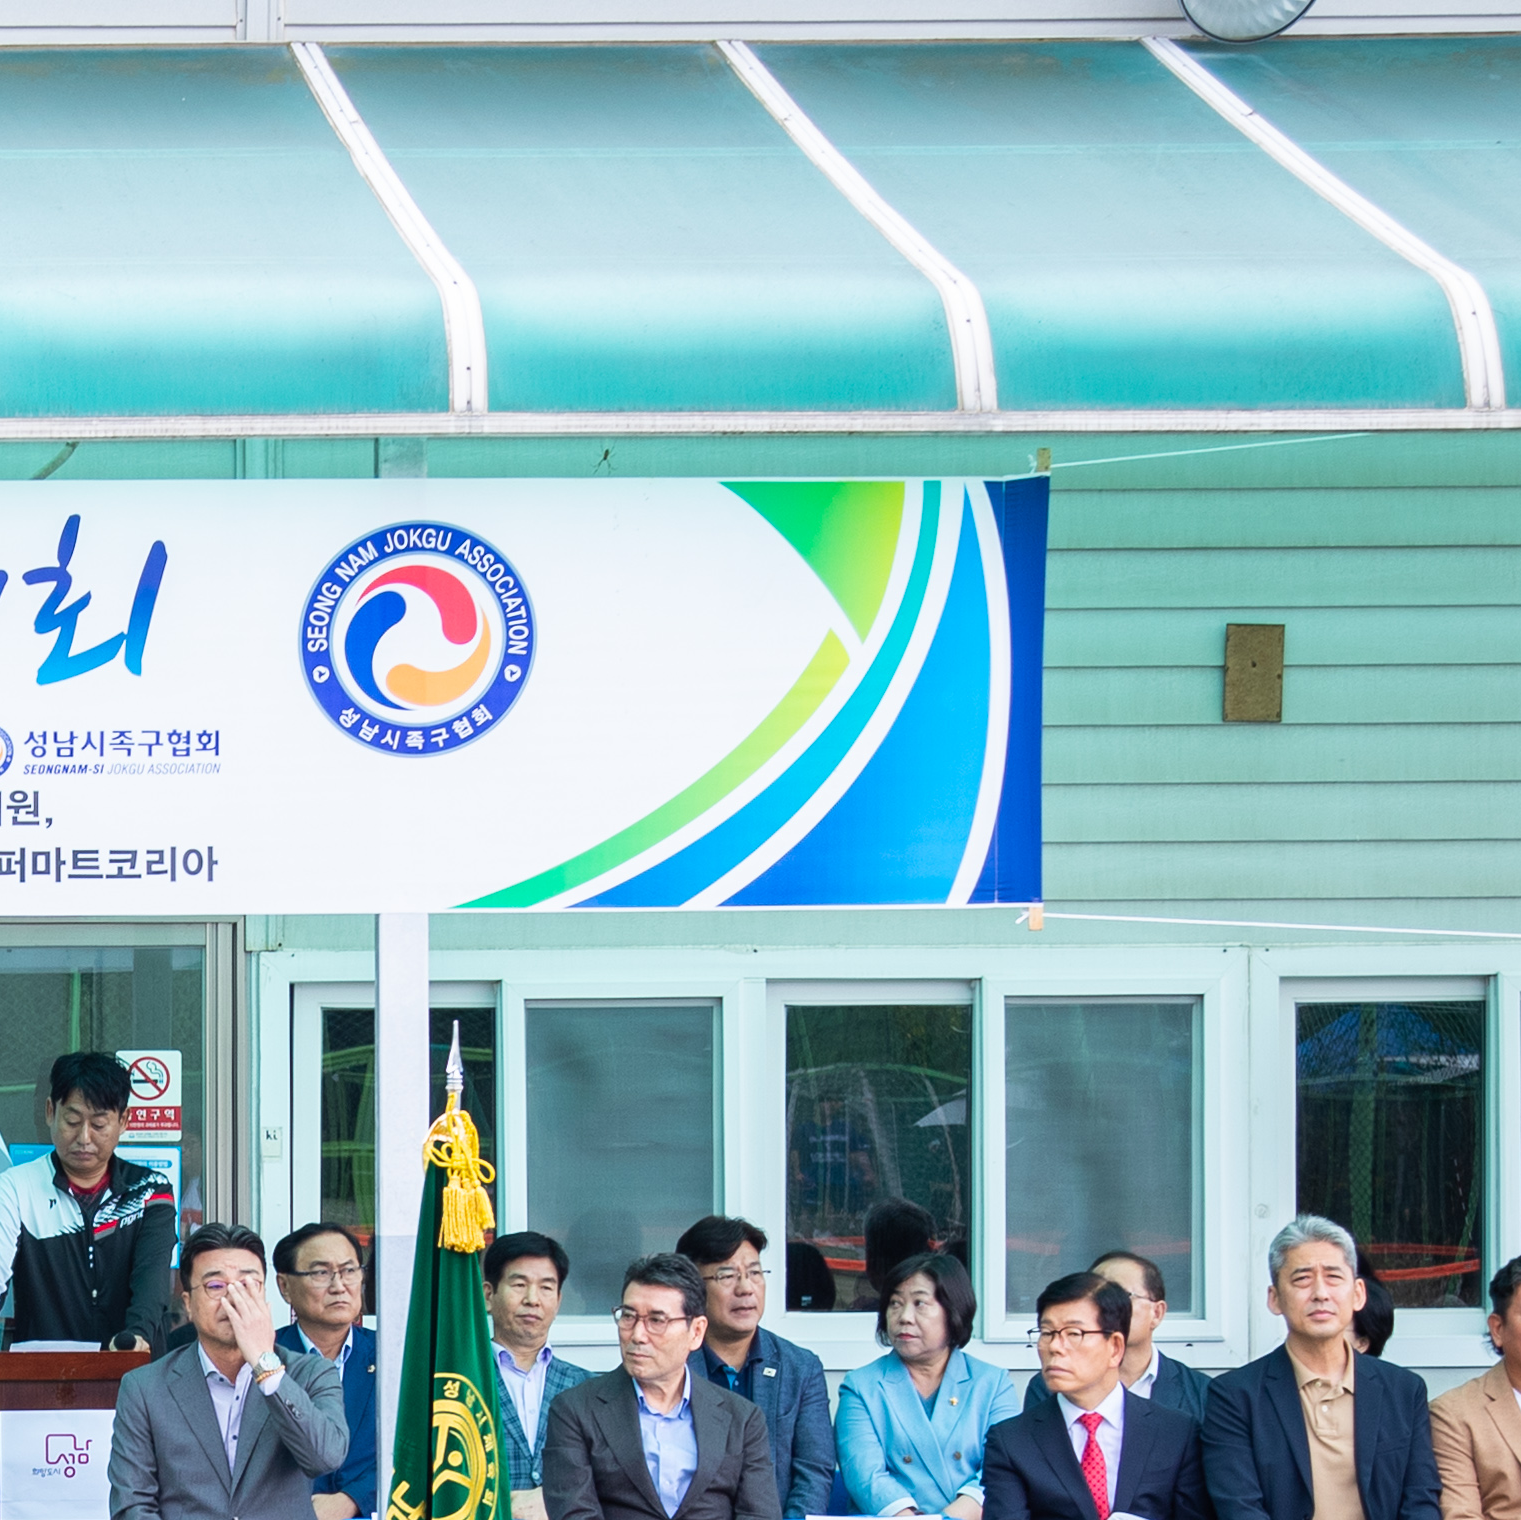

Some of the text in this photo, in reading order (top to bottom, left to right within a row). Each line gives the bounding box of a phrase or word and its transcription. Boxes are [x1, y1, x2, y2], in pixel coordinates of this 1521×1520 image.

[307, 528, 529, 655] SEONG NAM JOKGU ASSOCIATION
[339, 703, 493, 750] 성남시족구협회
[24, 729, 219, 758] 성남시족구협회
[24, 763, 221, 774] SEONGNAM-SI JOKGU ASSOCIATION
[128, 1108, 175, 1121] 연구역
[32, 1467, 61, 1478] 희망도시
